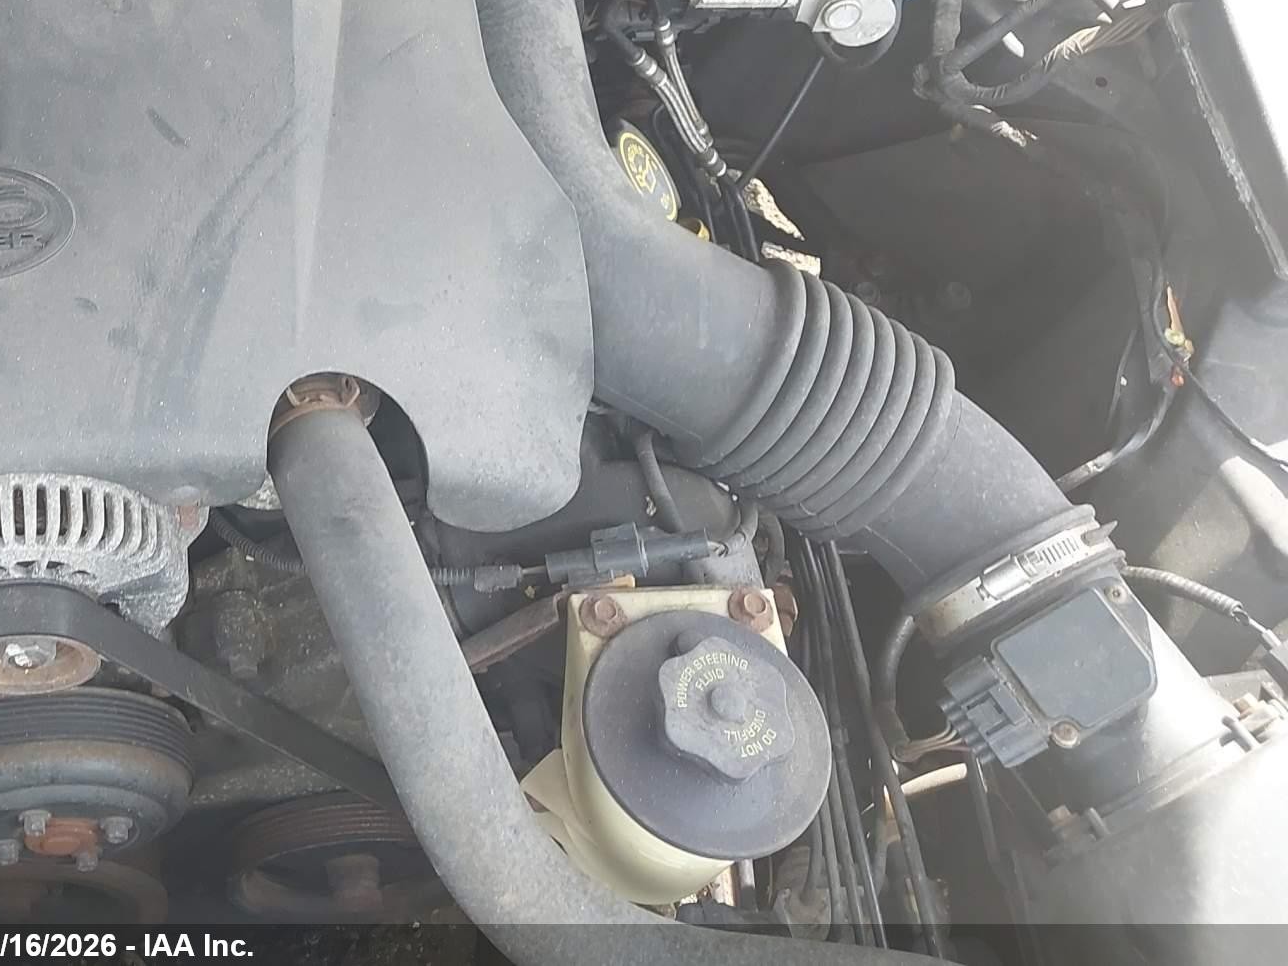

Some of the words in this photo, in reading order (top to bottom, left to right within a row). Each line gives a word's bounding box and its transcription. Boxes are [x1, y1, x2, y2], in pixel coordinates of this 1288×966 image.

[677, 666, 696, 709] POWER
[693, 652, 749, 671] STEERING
[695, 667, 725, 691] FLUID
[724, 709, 766, 742] OVERFILL
[762, 728, 777, 745] DO
[740, 740, 764, 758] NOT
